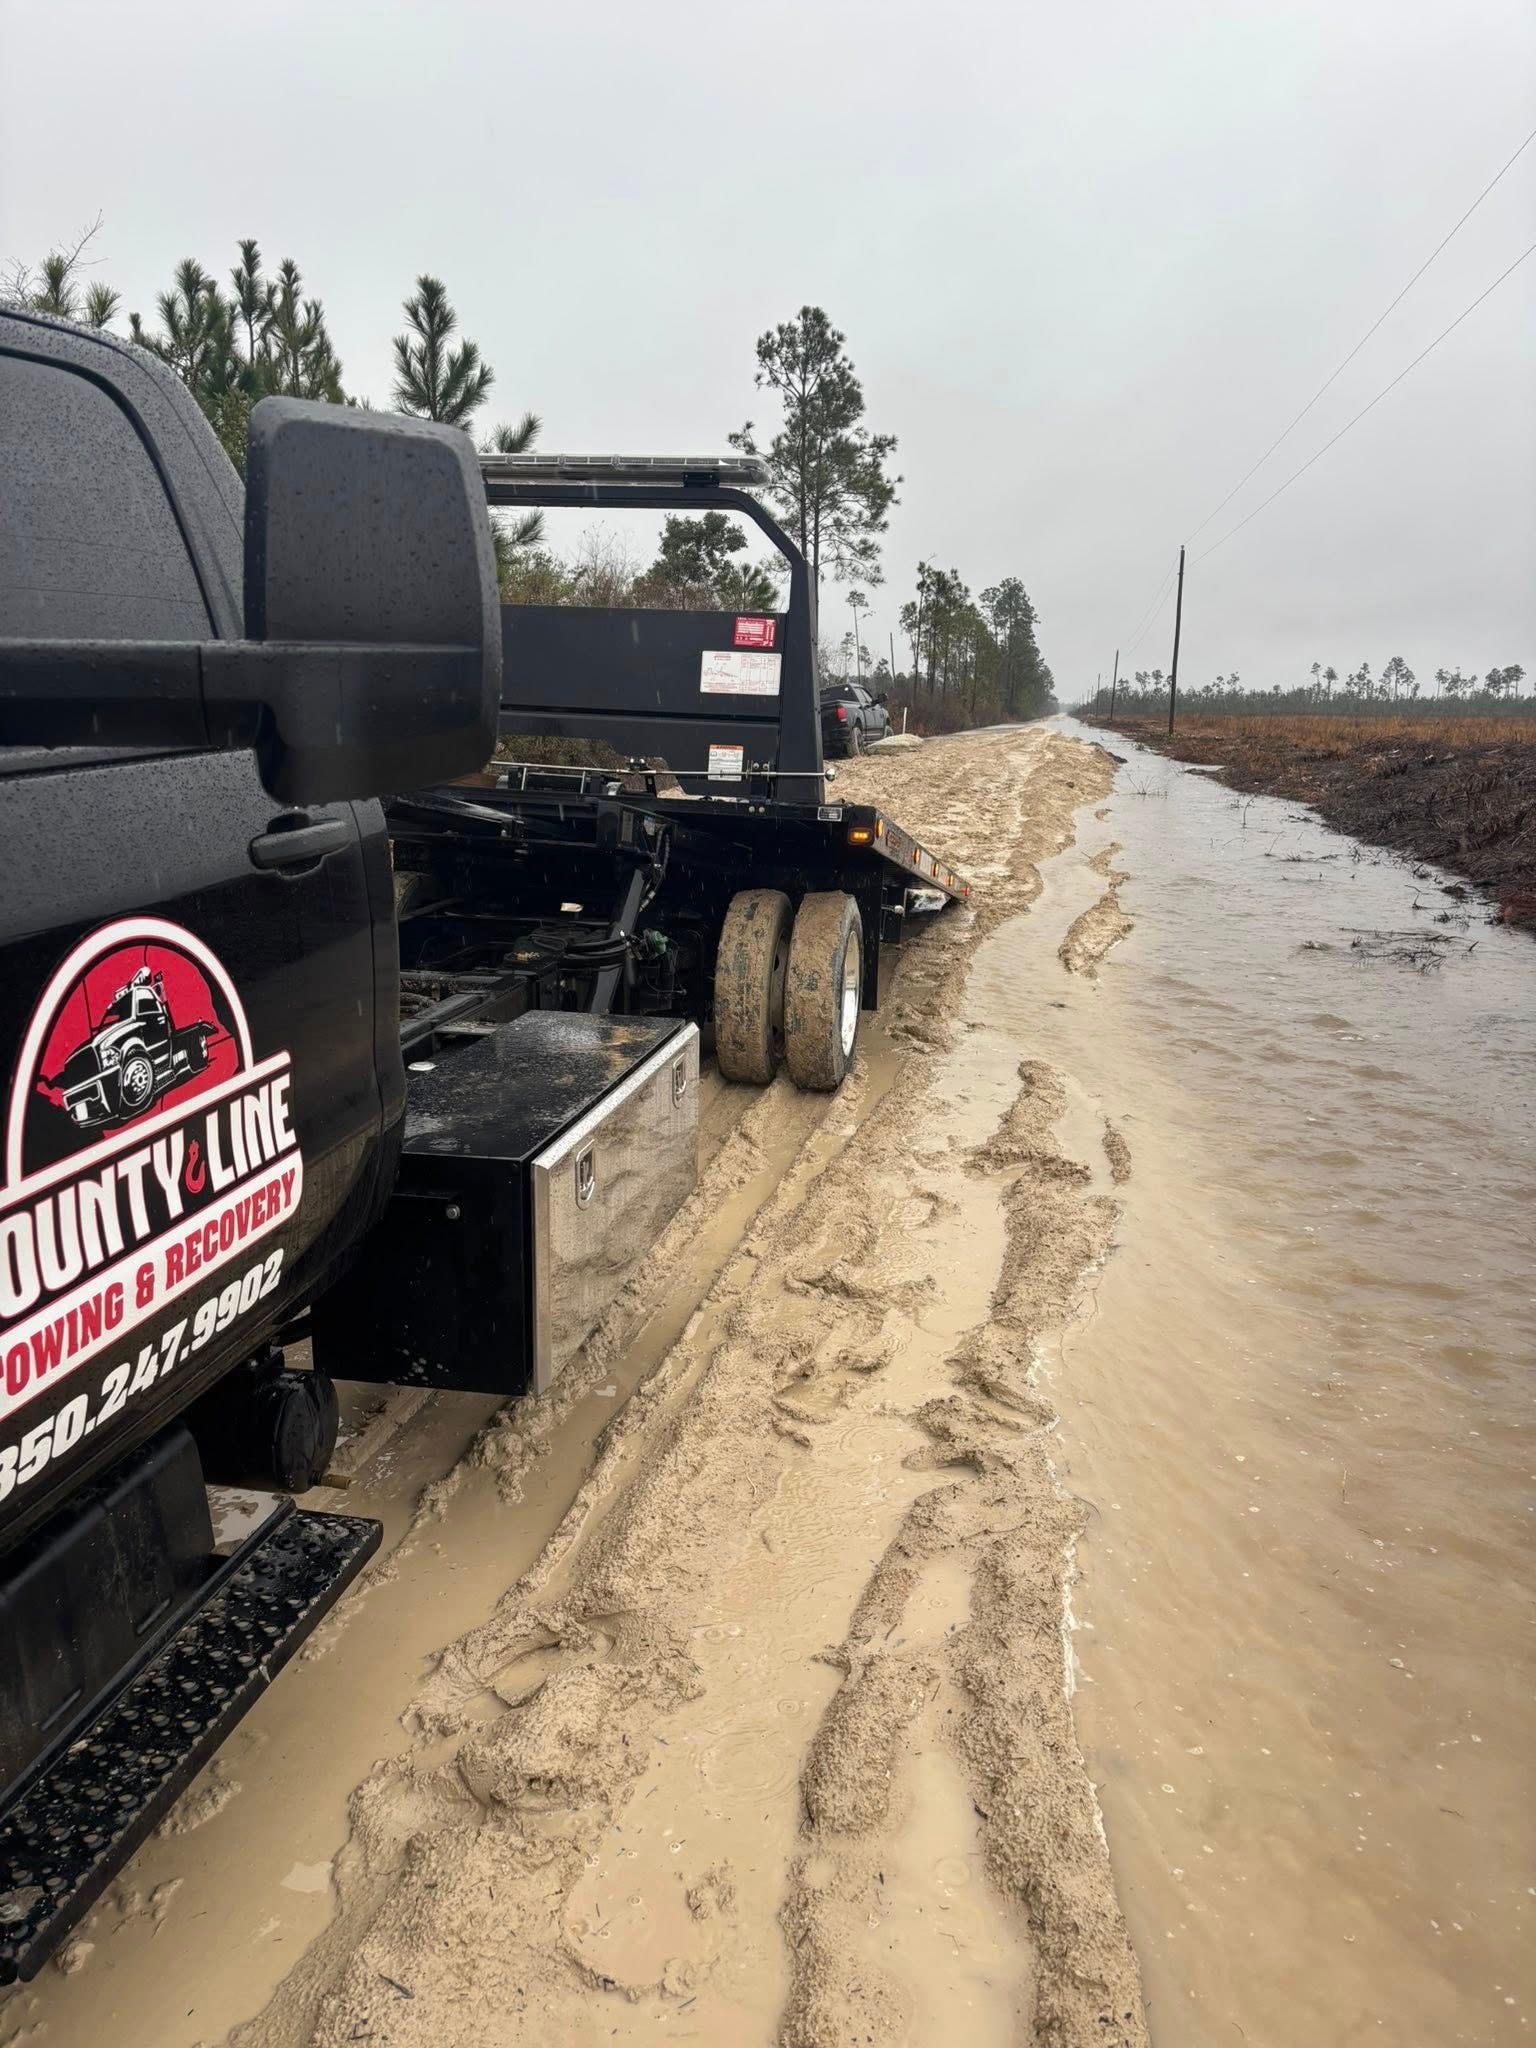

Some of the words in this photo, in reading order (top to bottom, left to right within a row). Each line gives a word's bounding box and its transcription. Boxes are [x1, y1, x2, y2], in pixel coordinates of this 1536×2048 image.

[0, 1128, 184, 1318] OUNTY
[206, 1073, 297, 1193] LINE
[0, 1282, 124, 1396] OWING
[136, 1262, 155, 1309] &
[165, 1167, 296, 1291] RECOVERY
